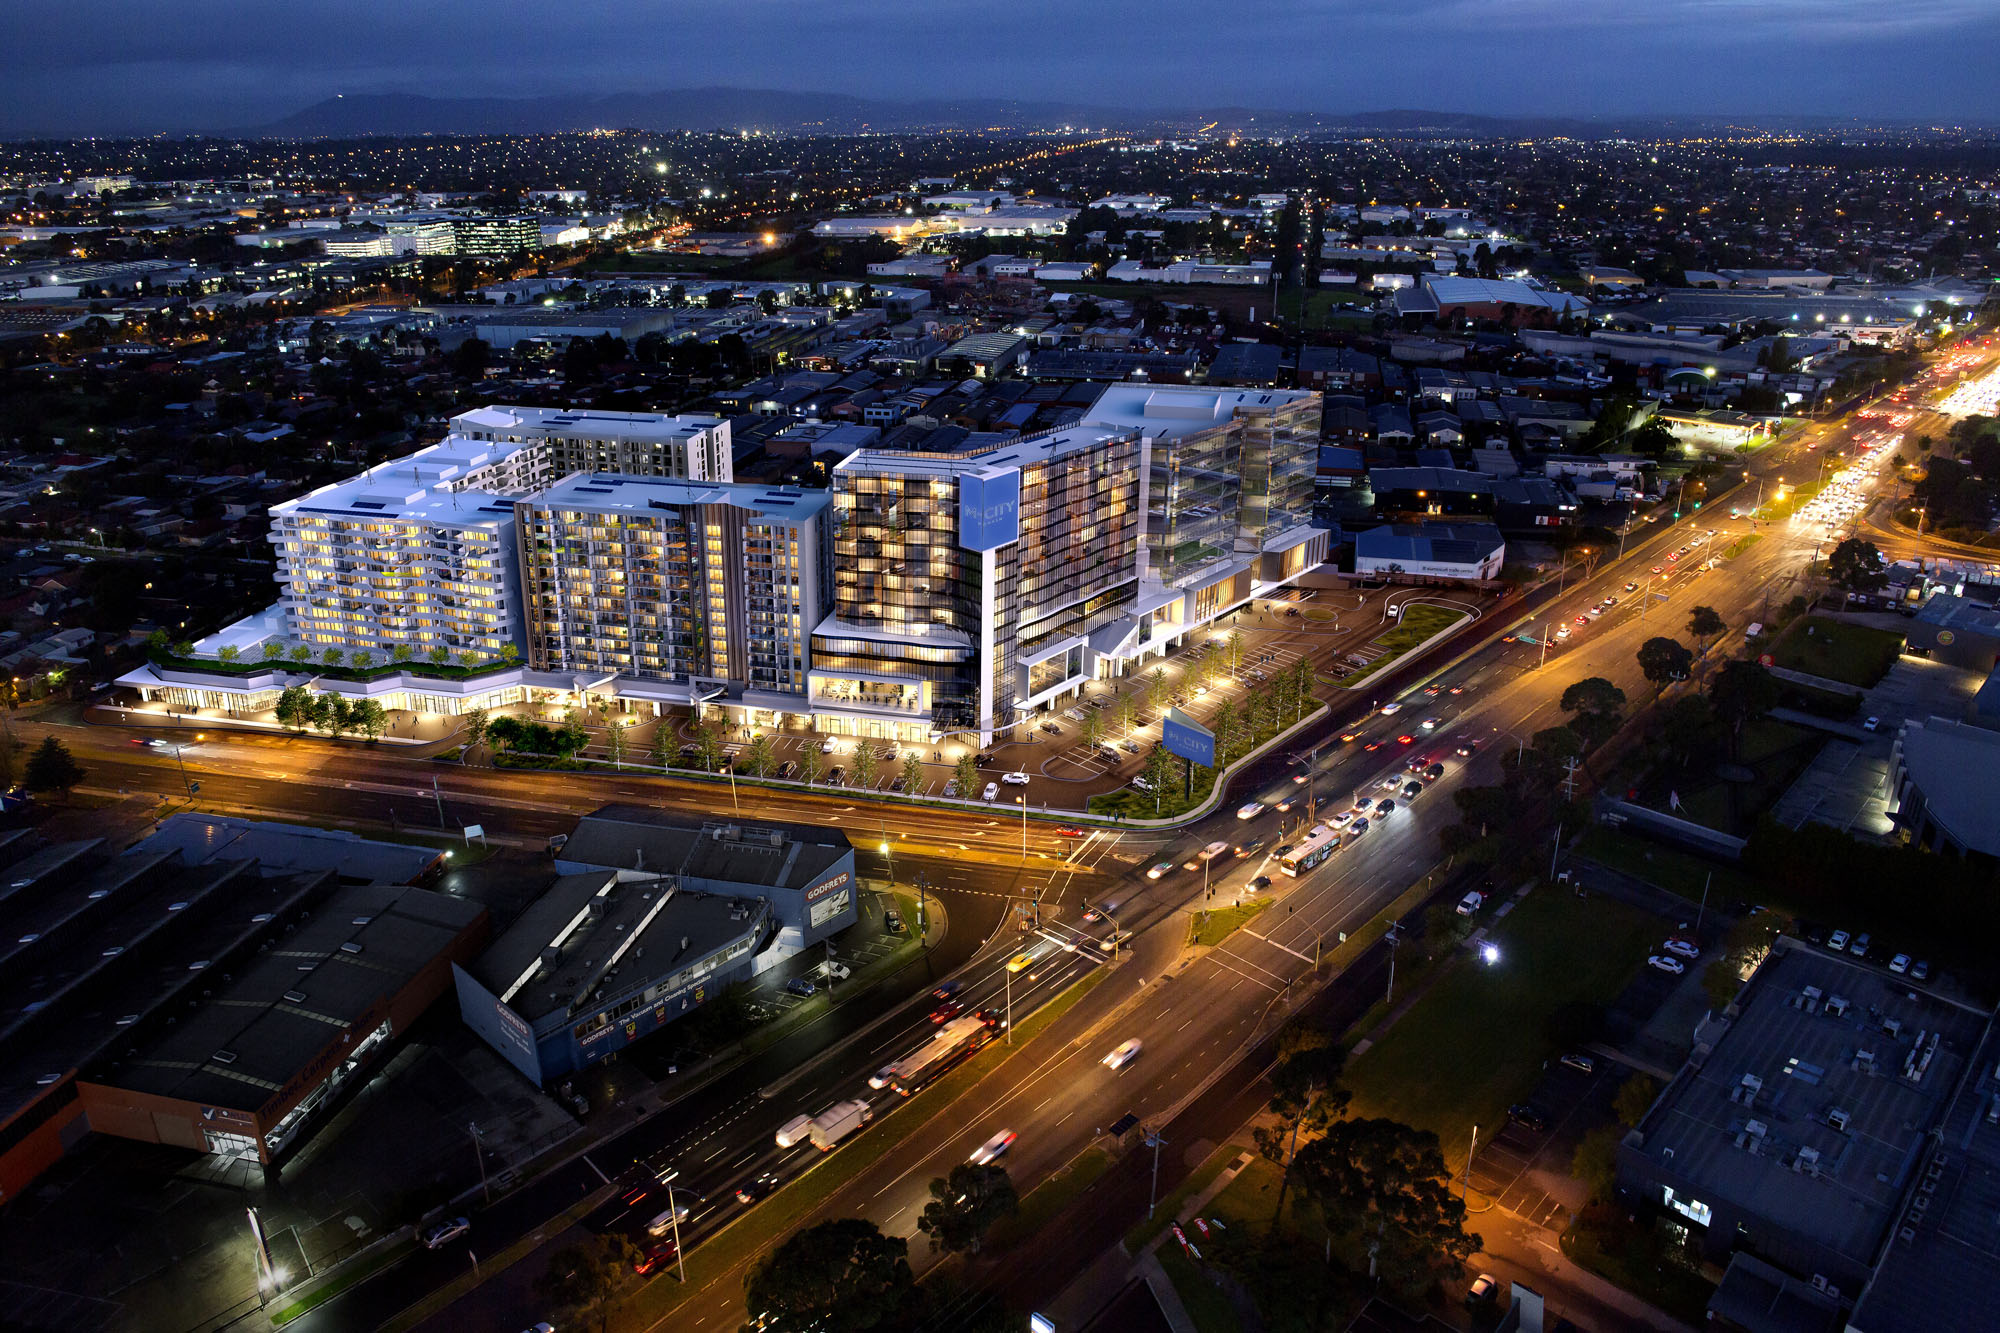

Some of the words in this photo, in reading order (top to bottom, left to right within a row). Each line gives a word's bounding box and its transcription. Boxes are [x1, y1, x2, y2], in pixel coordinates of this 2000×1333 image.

[807, 873, 847, 899] GODFREYS
[582, 1024, 614, 1045] GODFREYS
[619, 1017, 630, 1025] The
[654, 999, 664, 1008] and
